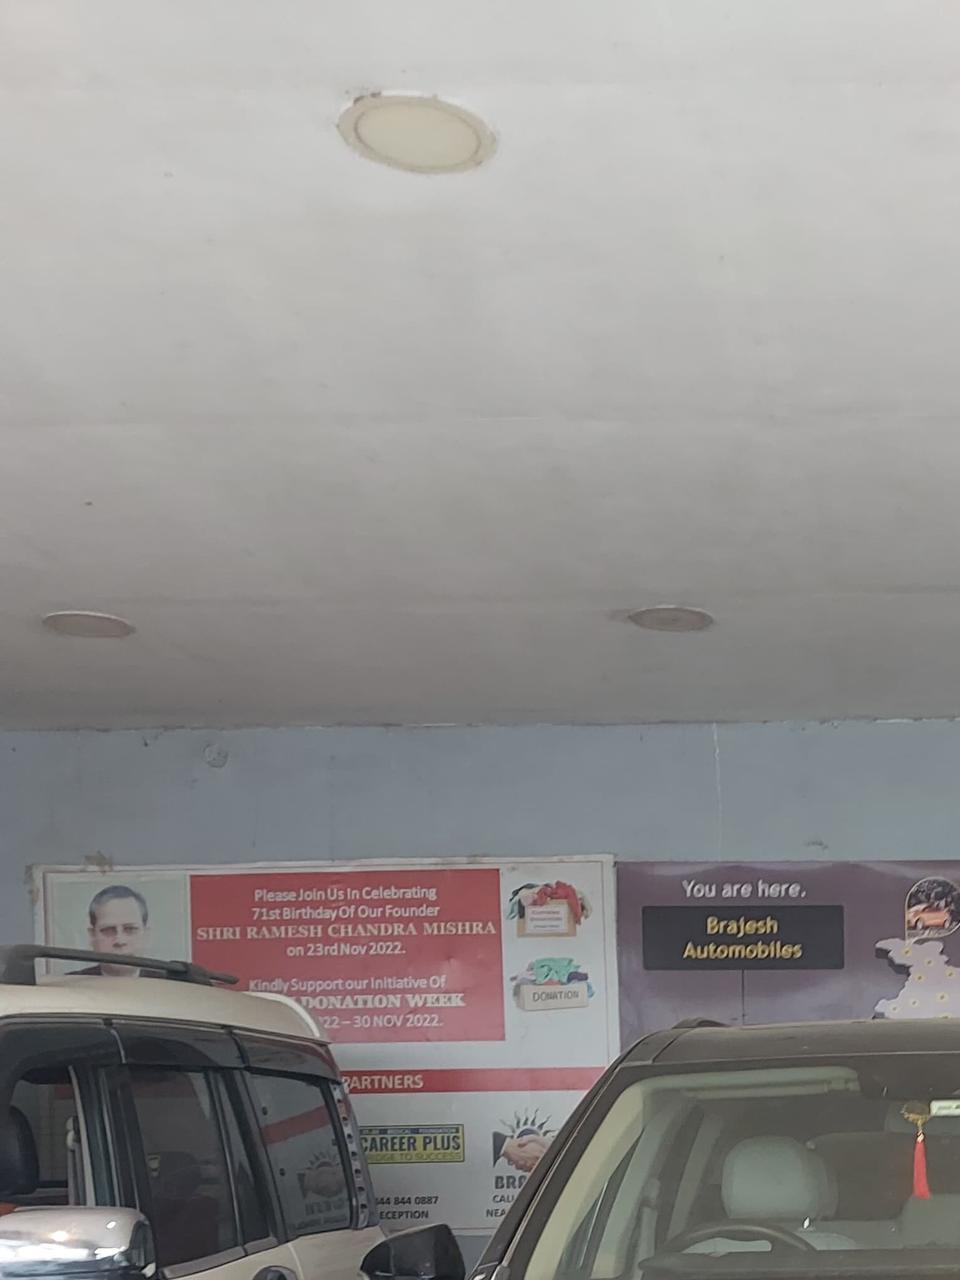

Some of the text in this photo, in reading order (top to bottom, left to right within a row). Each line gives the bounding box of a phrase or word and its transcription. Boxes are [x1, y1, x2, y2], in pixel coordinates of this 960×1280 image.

[254, 886, 437, 902] Please Join Us In Celebrating
[682, 879, 807, 898] You are here.
[252, 905, 440, 922] 71st Birthday Of Our Founder
[196, 921, 497, 941] SHRI RAMESH CHANDRA MISHRA
[706, 916, 778, 938] Brajesh
[286, 942, 407, 957] on 23rd Nov 2022.
[683, 940, 803, 960] Automobiles
[249, 975, 448, 994] Kindly Support our Initiative Of
[302, 993, 401, 1009] DONATION
[406, 992, 466, 1008] WEEK
[533, 990, 580, 1002] DONATION
[353, 1015, 371, 1028] 30
[373, 1014, 403, 1028] NOV
[406, 1013, 444, 1027] 2022.
[341, 1074, 424, 1090] PARTNERS
[360, 1135, 461, 1152] CAREER PLUS
[379, 1210, 429, 1220] ECEPTION
